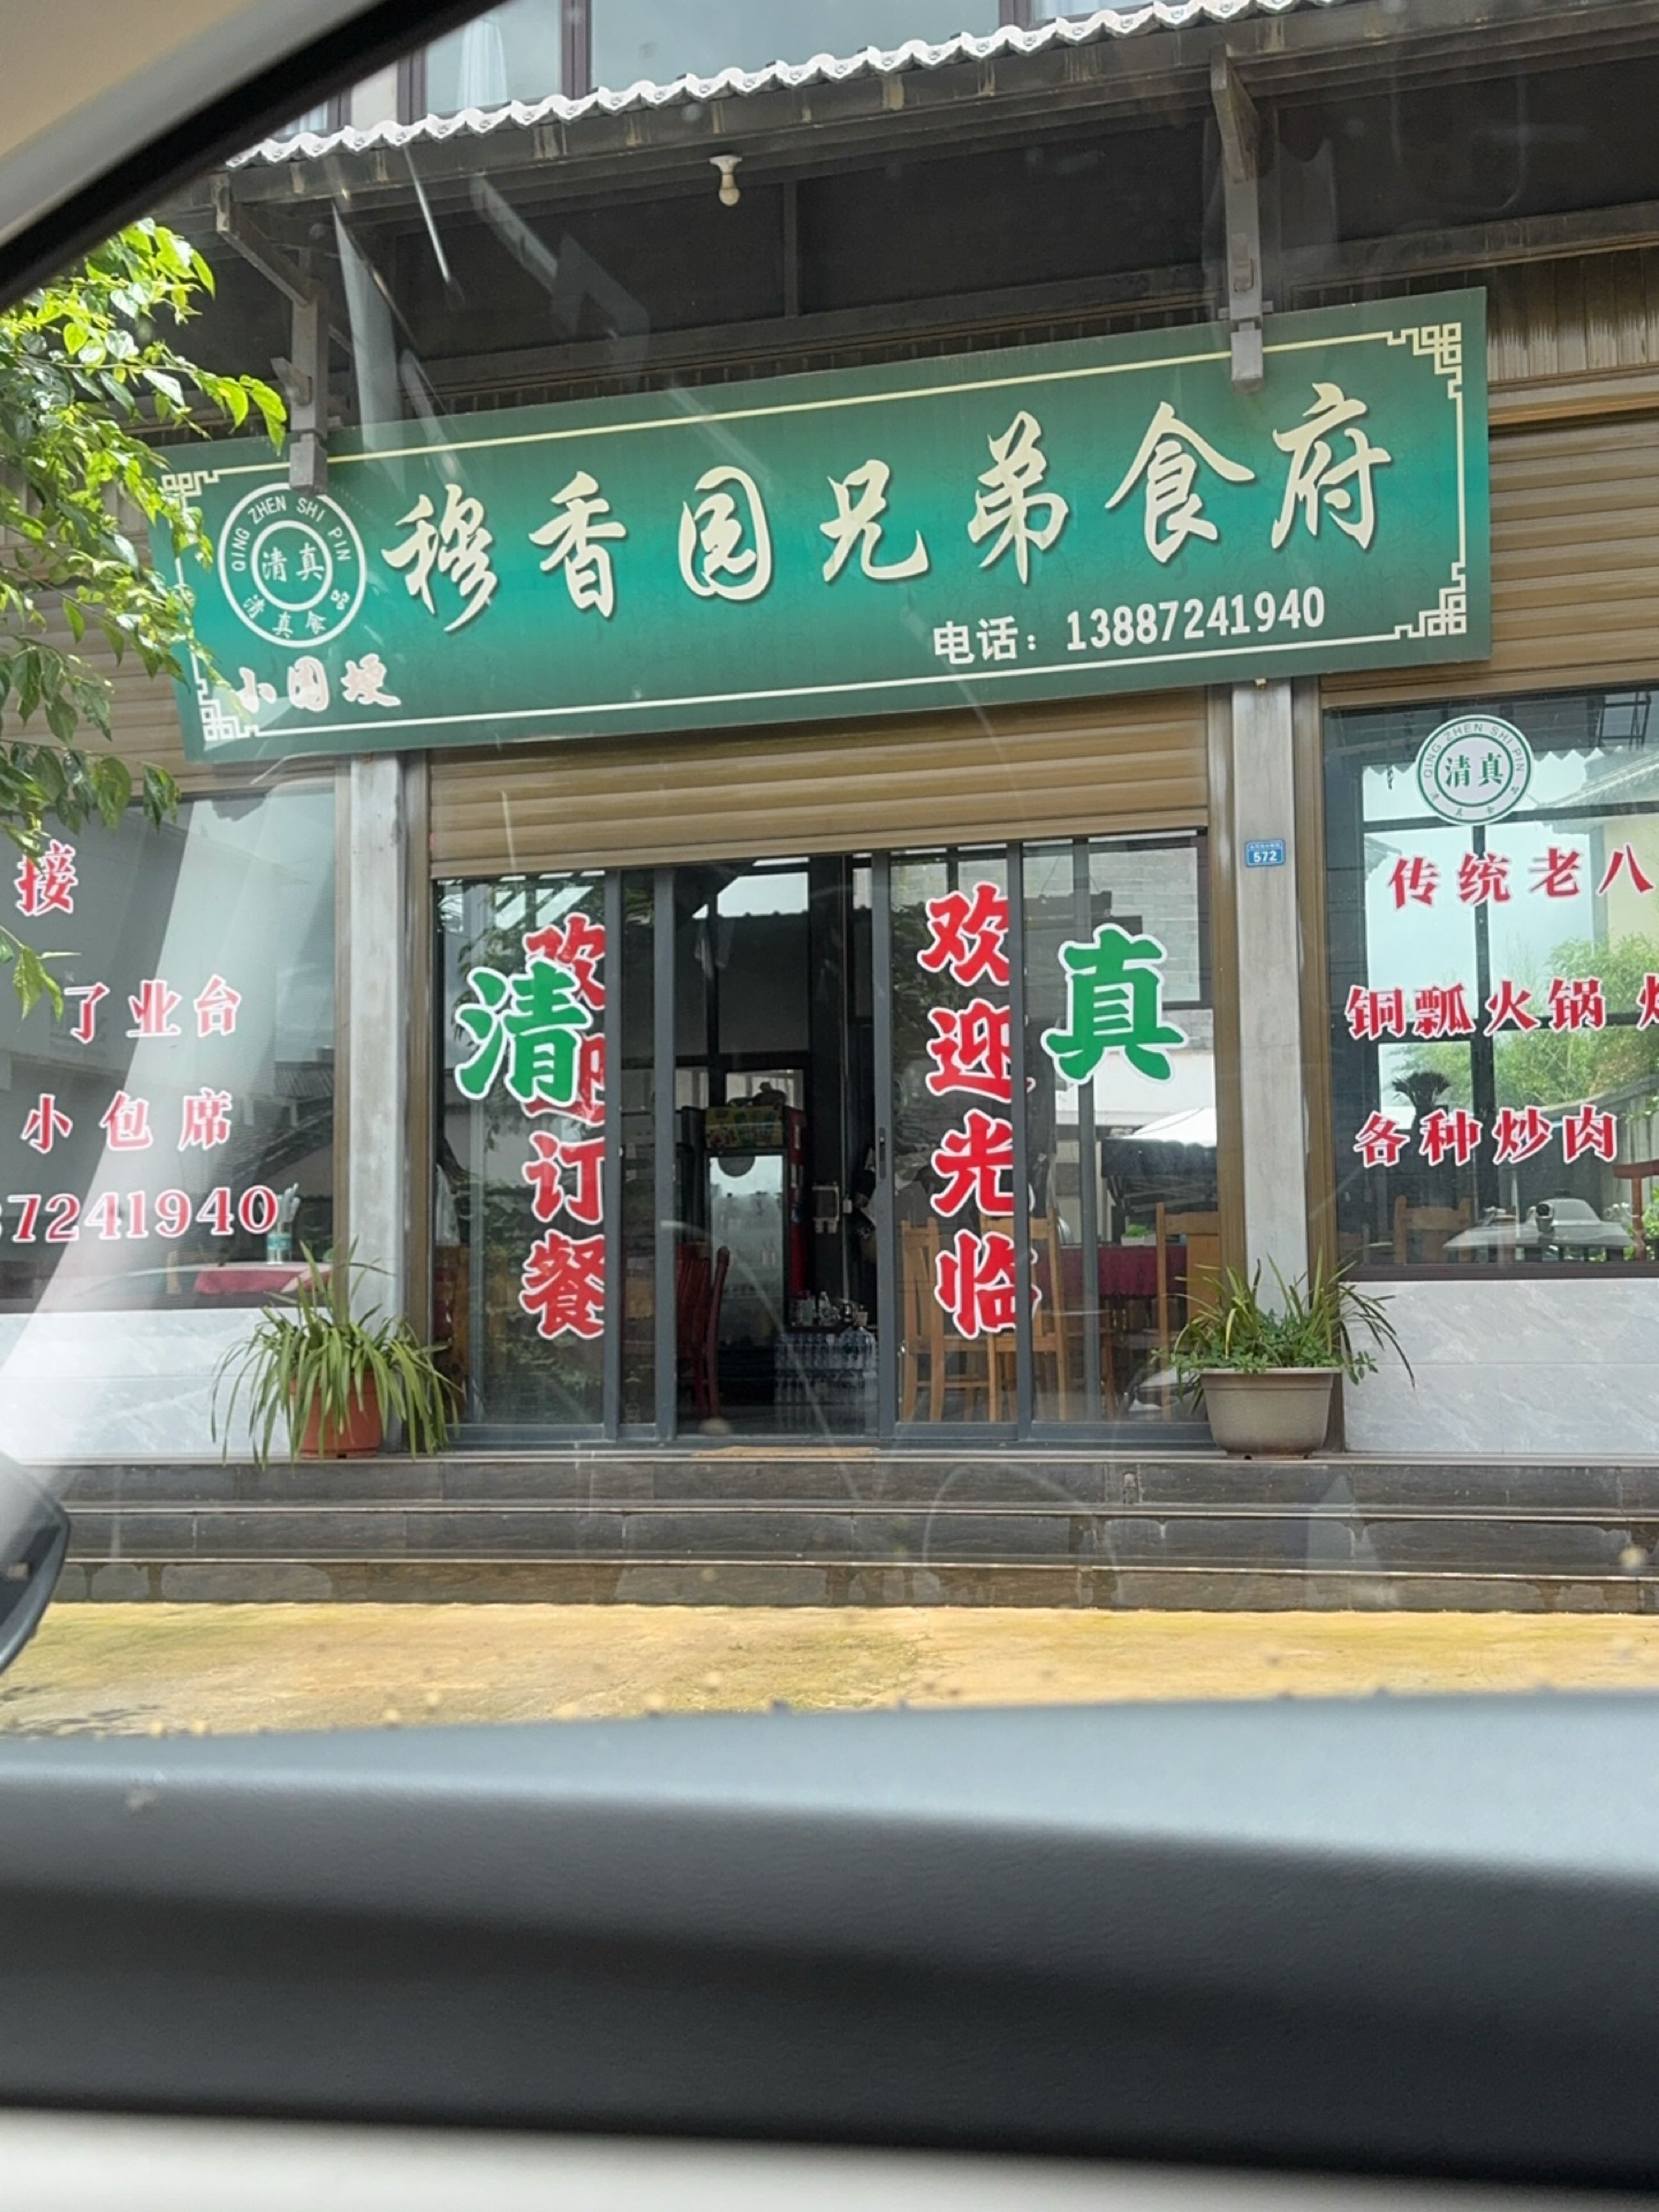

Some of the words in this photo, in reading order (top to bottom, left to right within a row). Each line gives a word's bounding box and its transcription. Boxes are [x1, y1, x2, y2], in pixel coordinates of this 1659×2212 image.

[231, 527, 250, 572] QING
[247, 496, 287, 524] ZHEN
[296, 497, 326, 522] SHI
[327, 526, 351, 561] PIN
[381, 382, 1391, 631] 穆香园兄弟食府
[262, 541, 325, 582] 清真
[243, 589, 350, 639] 清真食品
[1423, 743, 1443, 778] QING
[1445, 723, 1483, 741] ZHEN
[1490, 726, 1514, 745] SHI
[1513, 748, 1525, 772] PIN
[1445, 752, 1503, 788] 清真
[13, 839, 79, 917] 接
[1253, 851, 1277, 863] 572
[1389, 844, 1655, 910] 传统老八
[456, 960, 592, 1106] 清
[1042, 924, 1189, 1084] 真
[21, 1088, 233, 1153] 小包席
[918, 881, 1041, 1339] 欢迎光临
[1354, 1105, 1617, 1167] 各种炒肉
[0, 1185, 279, 1244] 7241940
